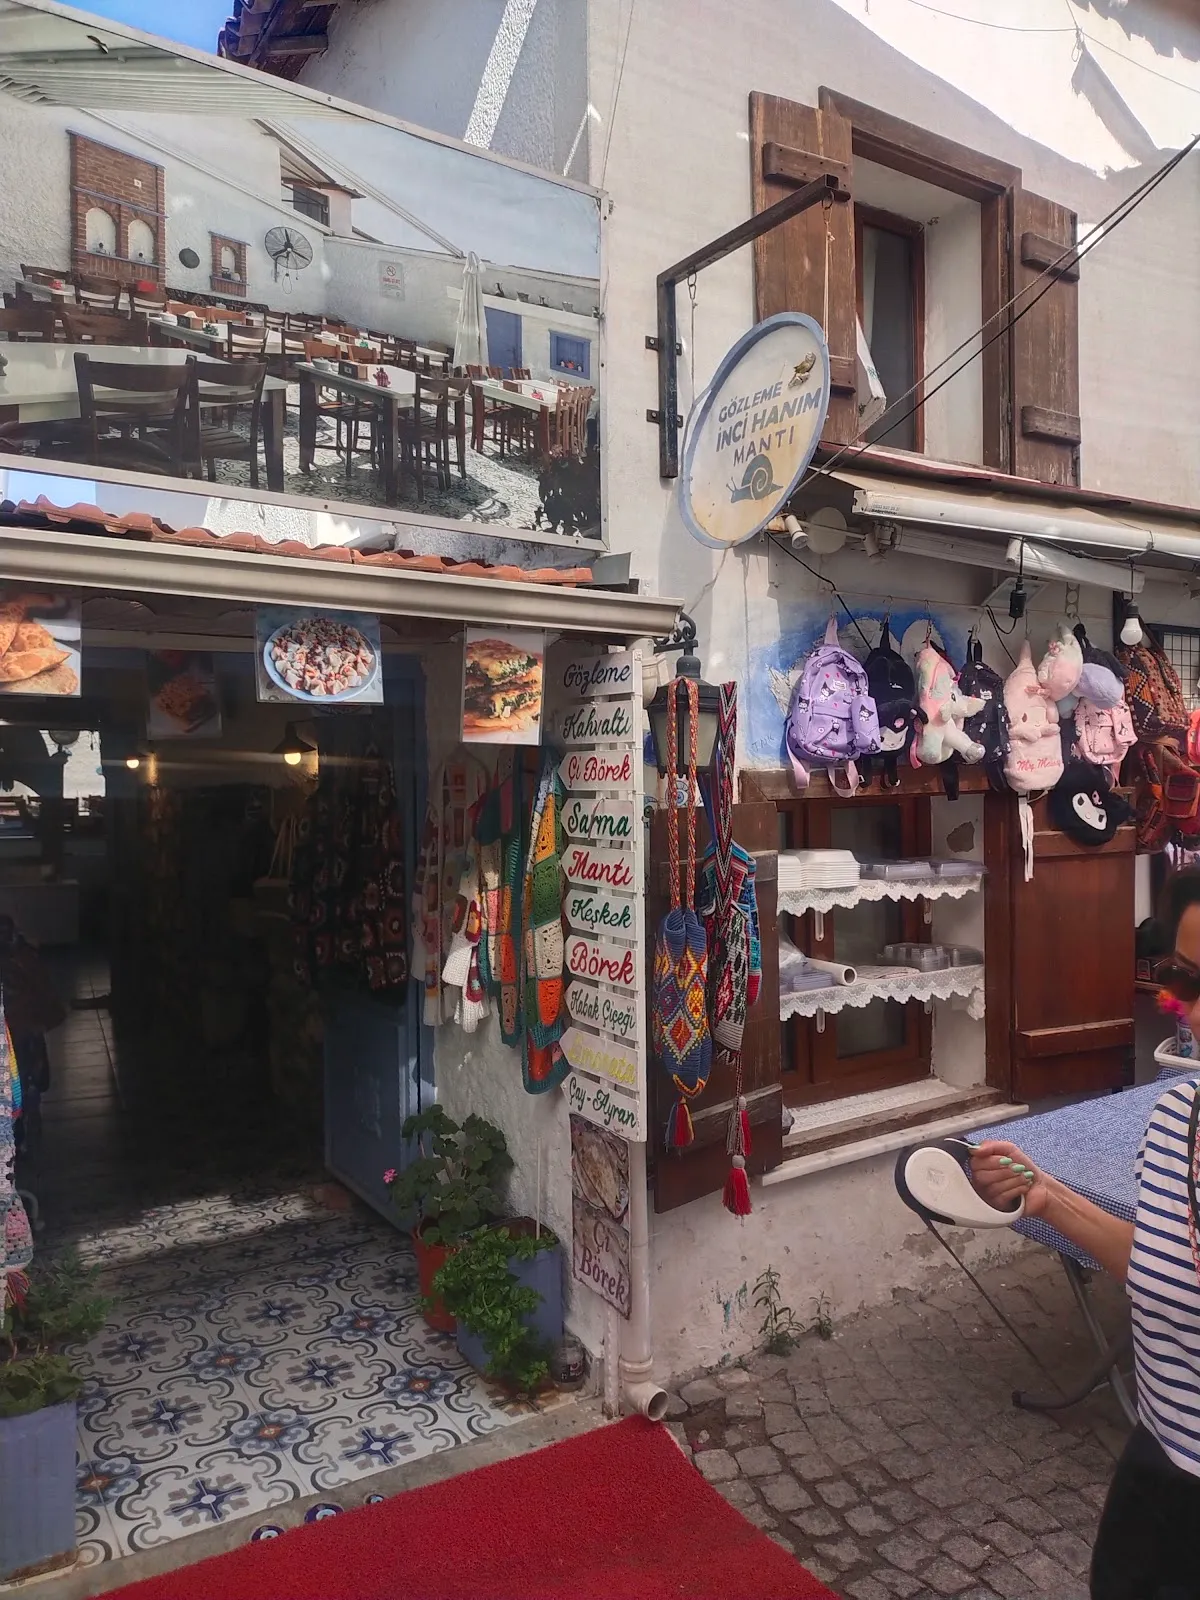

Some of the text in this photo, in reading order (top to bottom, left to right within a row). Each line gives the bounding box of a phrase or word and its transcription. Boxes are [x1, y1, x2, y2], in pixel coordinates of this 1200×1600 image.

[715, 387, 822, 452] İNCİ HANIM
[719, 381, 783, 423] GÖZLEME
[733, 426, 795, 466] MANTI
[564, 660, 632, 695] Gözleme
[563, 706, 632, 740] Kahvaltı
[567, 754, 631, 789] Çi Börek
[568, 802, 632, 838] Sarma
[568, 850, 633, 886] Mantı
[571, 897, 632, 929] Keşkek
[570, 941, 635, 985] Börek
[570, 990, 636, 1036] Kabak Çiçeği
[579, 1219, 625, 1305] Çi Börek
